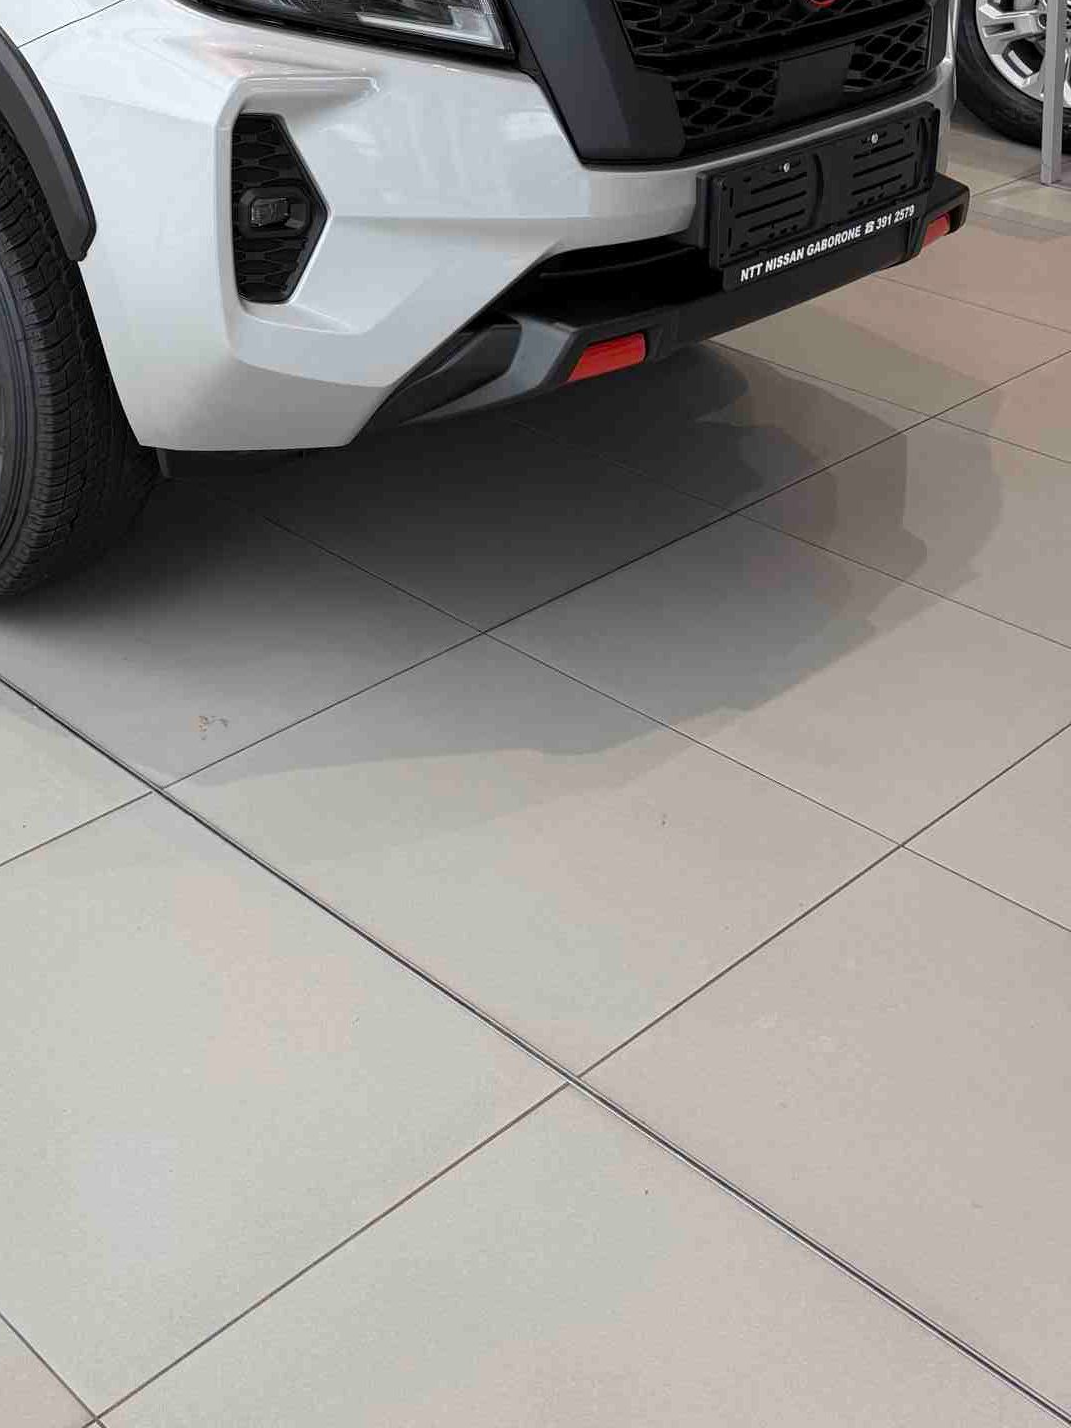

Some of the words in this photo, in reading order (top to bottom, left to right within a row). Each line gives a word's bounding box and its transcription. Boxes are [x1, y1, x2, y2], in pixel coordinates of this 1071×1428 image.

[740, 262, 764, 282] NTT
[765, 248, 805, 273] NISSAN
[806, 226, 862, 257] GABORONE
[876, 213, 892, 231] 391
[893, 204, 916, 224] 2579
